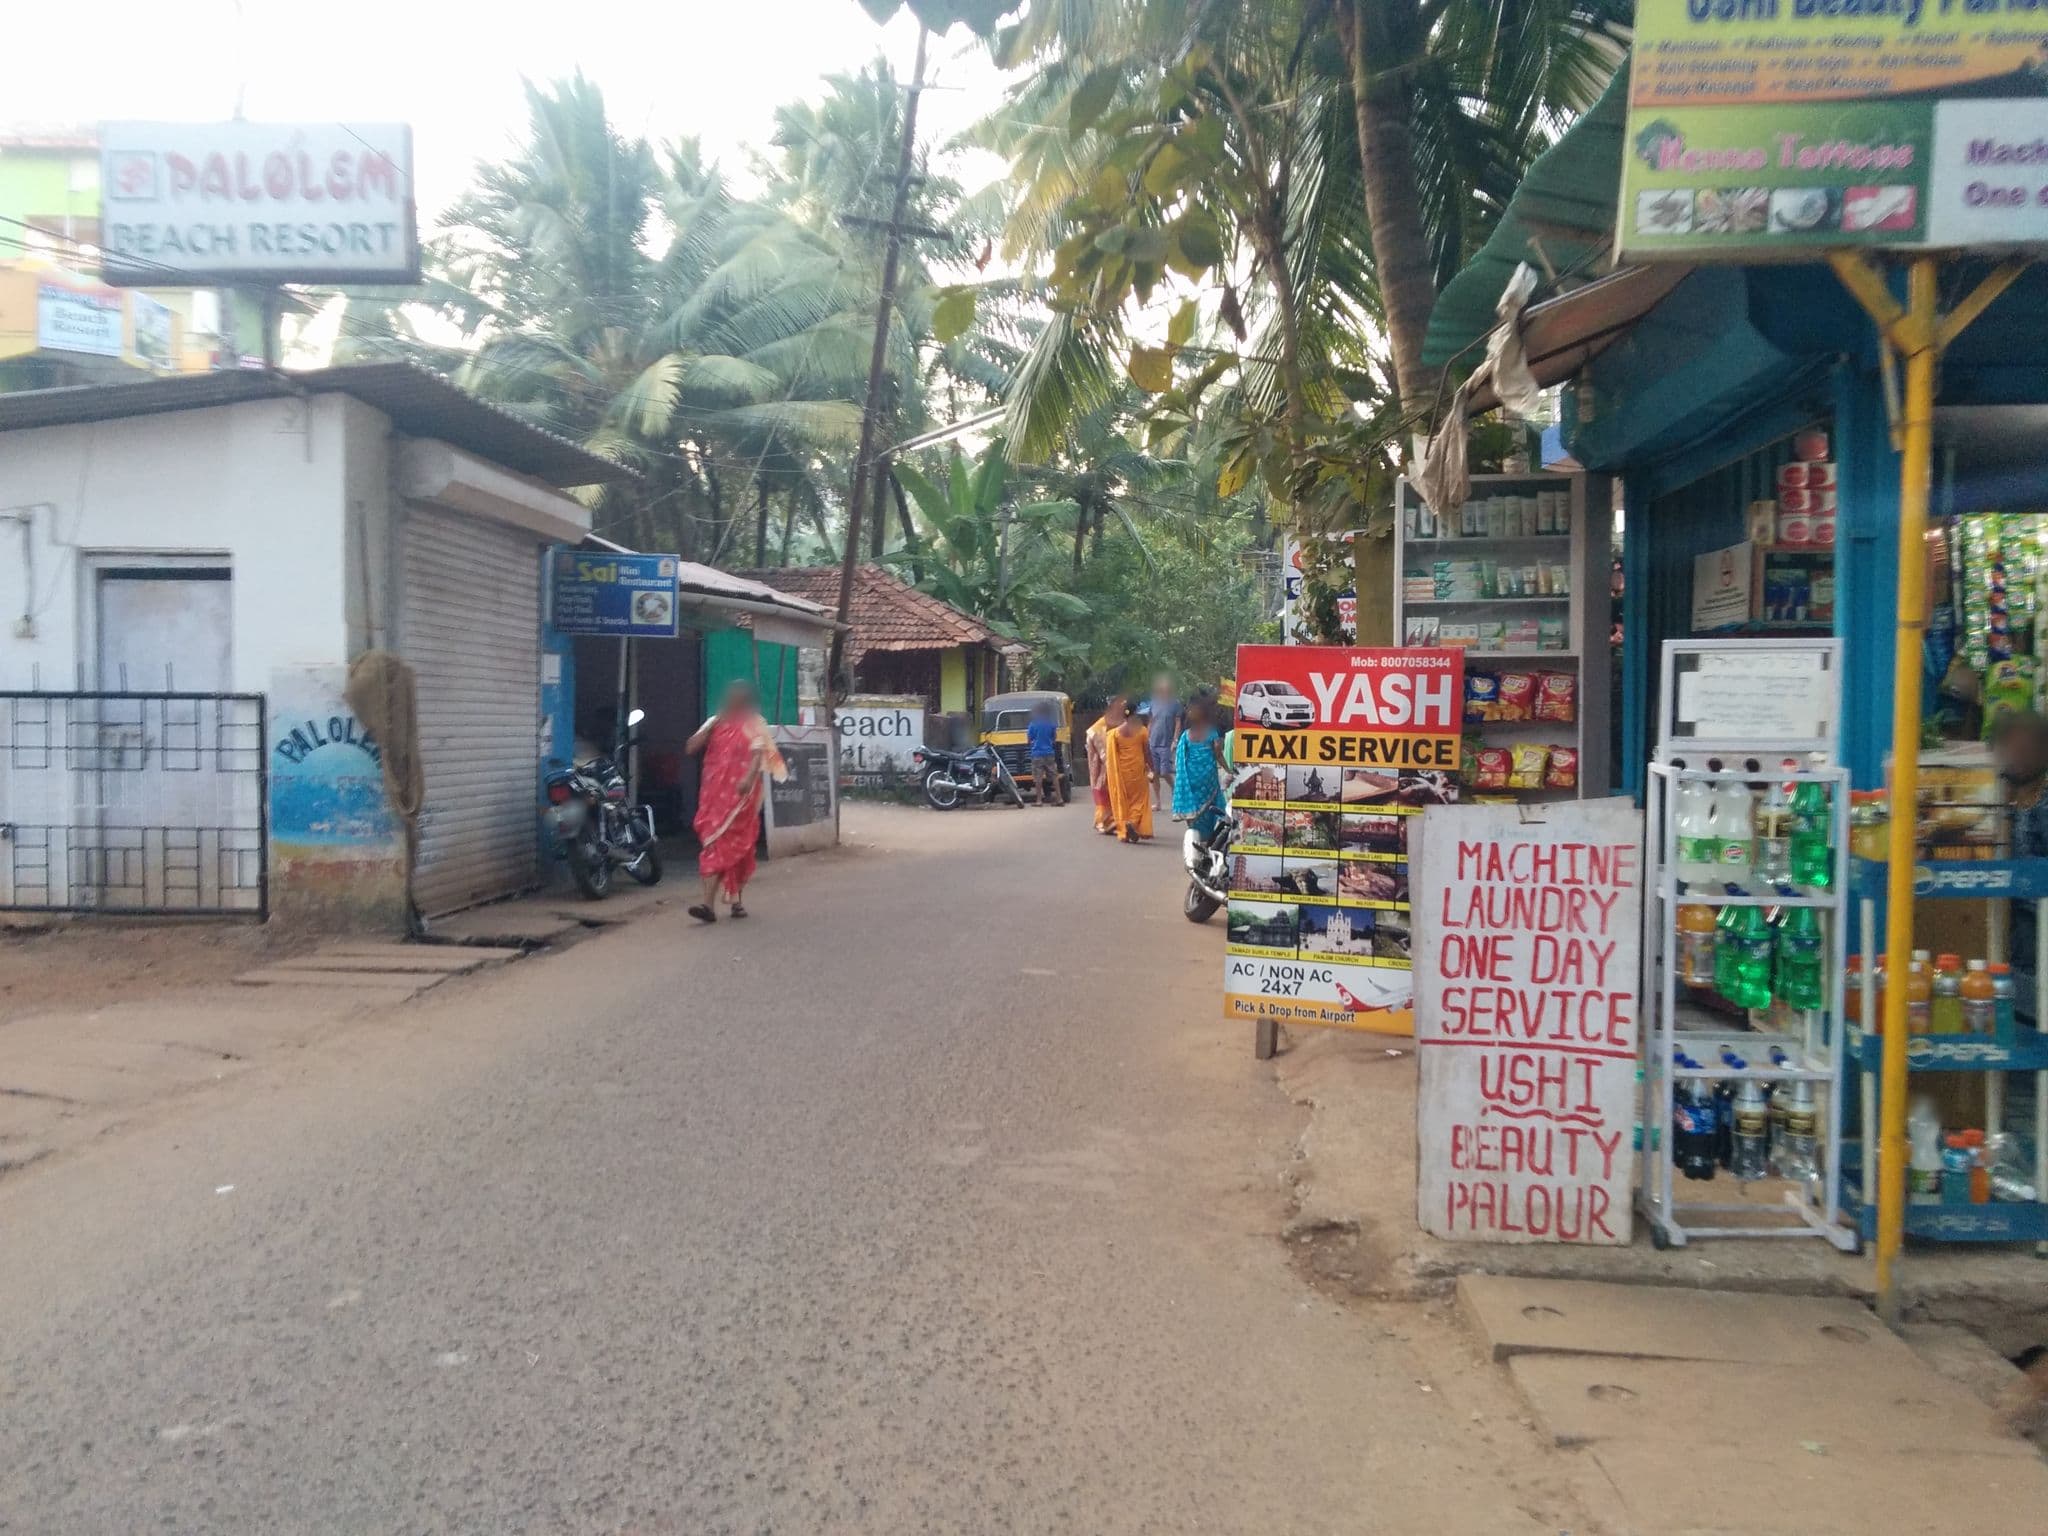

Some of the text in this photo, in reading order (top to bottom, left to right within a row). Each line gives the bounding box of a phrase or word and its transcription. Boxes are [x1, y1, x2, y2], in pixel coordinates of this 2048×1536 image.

[163, 150, 397, 201] PALOLEM
[110, 222, 394, 254] BEACH RESORT
[1350, 656, 1451, 669] Mob: 8007058344
[840, 709, 913, 737] each
[1309, 672, 1453, 727] YASH
[1241, 733, 1454, 766] TAXI SERVICE
[1458, 841, 1636, 888] MACHINE
[1442, 885, 1618, 935] LAUNDRY
[1232, 962, 1333, 983] AC / NON AC
[1440, 933, 1617, 987] ONE DAY
[1234, 1000, 1355, 1023] Pick & Drop from Airport
[1260, 979, 1302, 996] 24x7
[1441, 987, 1632, 1046] SERVICE
[1480, 1054, 1602, 1114] USHI
[1450, 1123, 1621, 1180] BEAUTY
[1447, 1181, 1615, 1239] PALOUR
